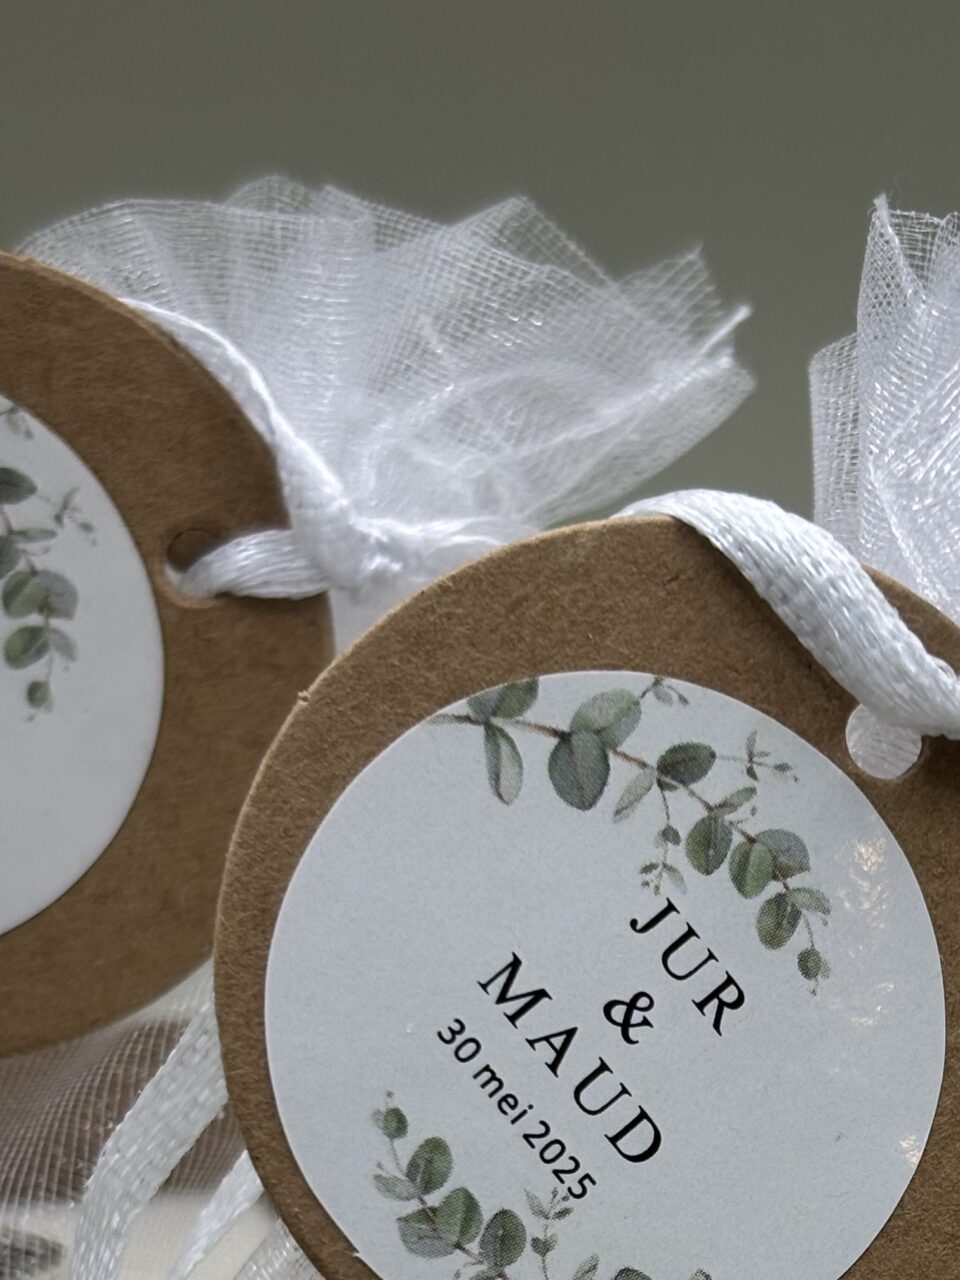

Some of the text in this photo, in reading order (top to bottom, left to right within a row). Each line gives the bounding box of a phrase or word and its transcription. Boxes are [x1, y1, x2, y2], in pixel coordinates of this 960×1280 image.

[603, 991, 655, 1045] &
[629, 897, 745, 1037] JUR
[437, 1018, 597, 1200] 30 mei 2025
[477, 952, 662, 1164] MAUD
